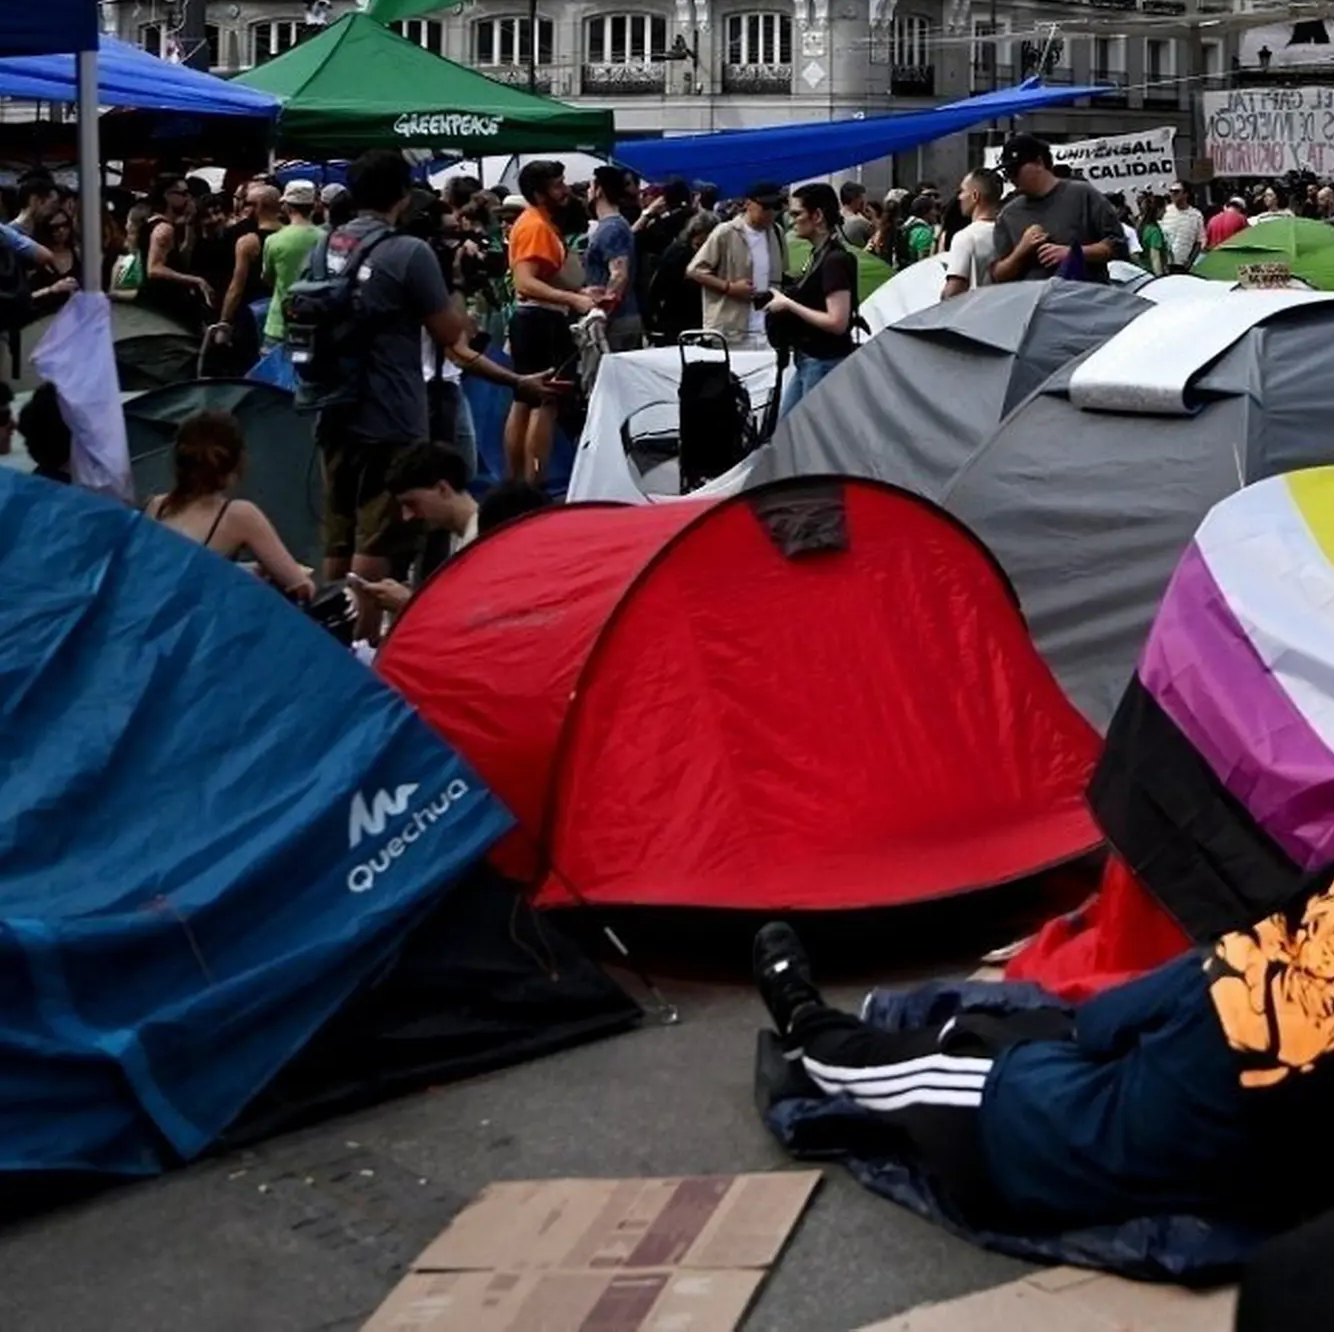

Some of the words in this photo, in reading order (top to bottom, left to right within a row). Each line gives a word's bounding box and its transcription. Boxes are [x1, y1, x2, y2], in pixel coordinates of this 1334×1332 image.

[393, 113, 504, 137] GREENPEACE
[1088, 159, 1173, 180] CALIDAD
[347, 778, 469, 893] Quechua
